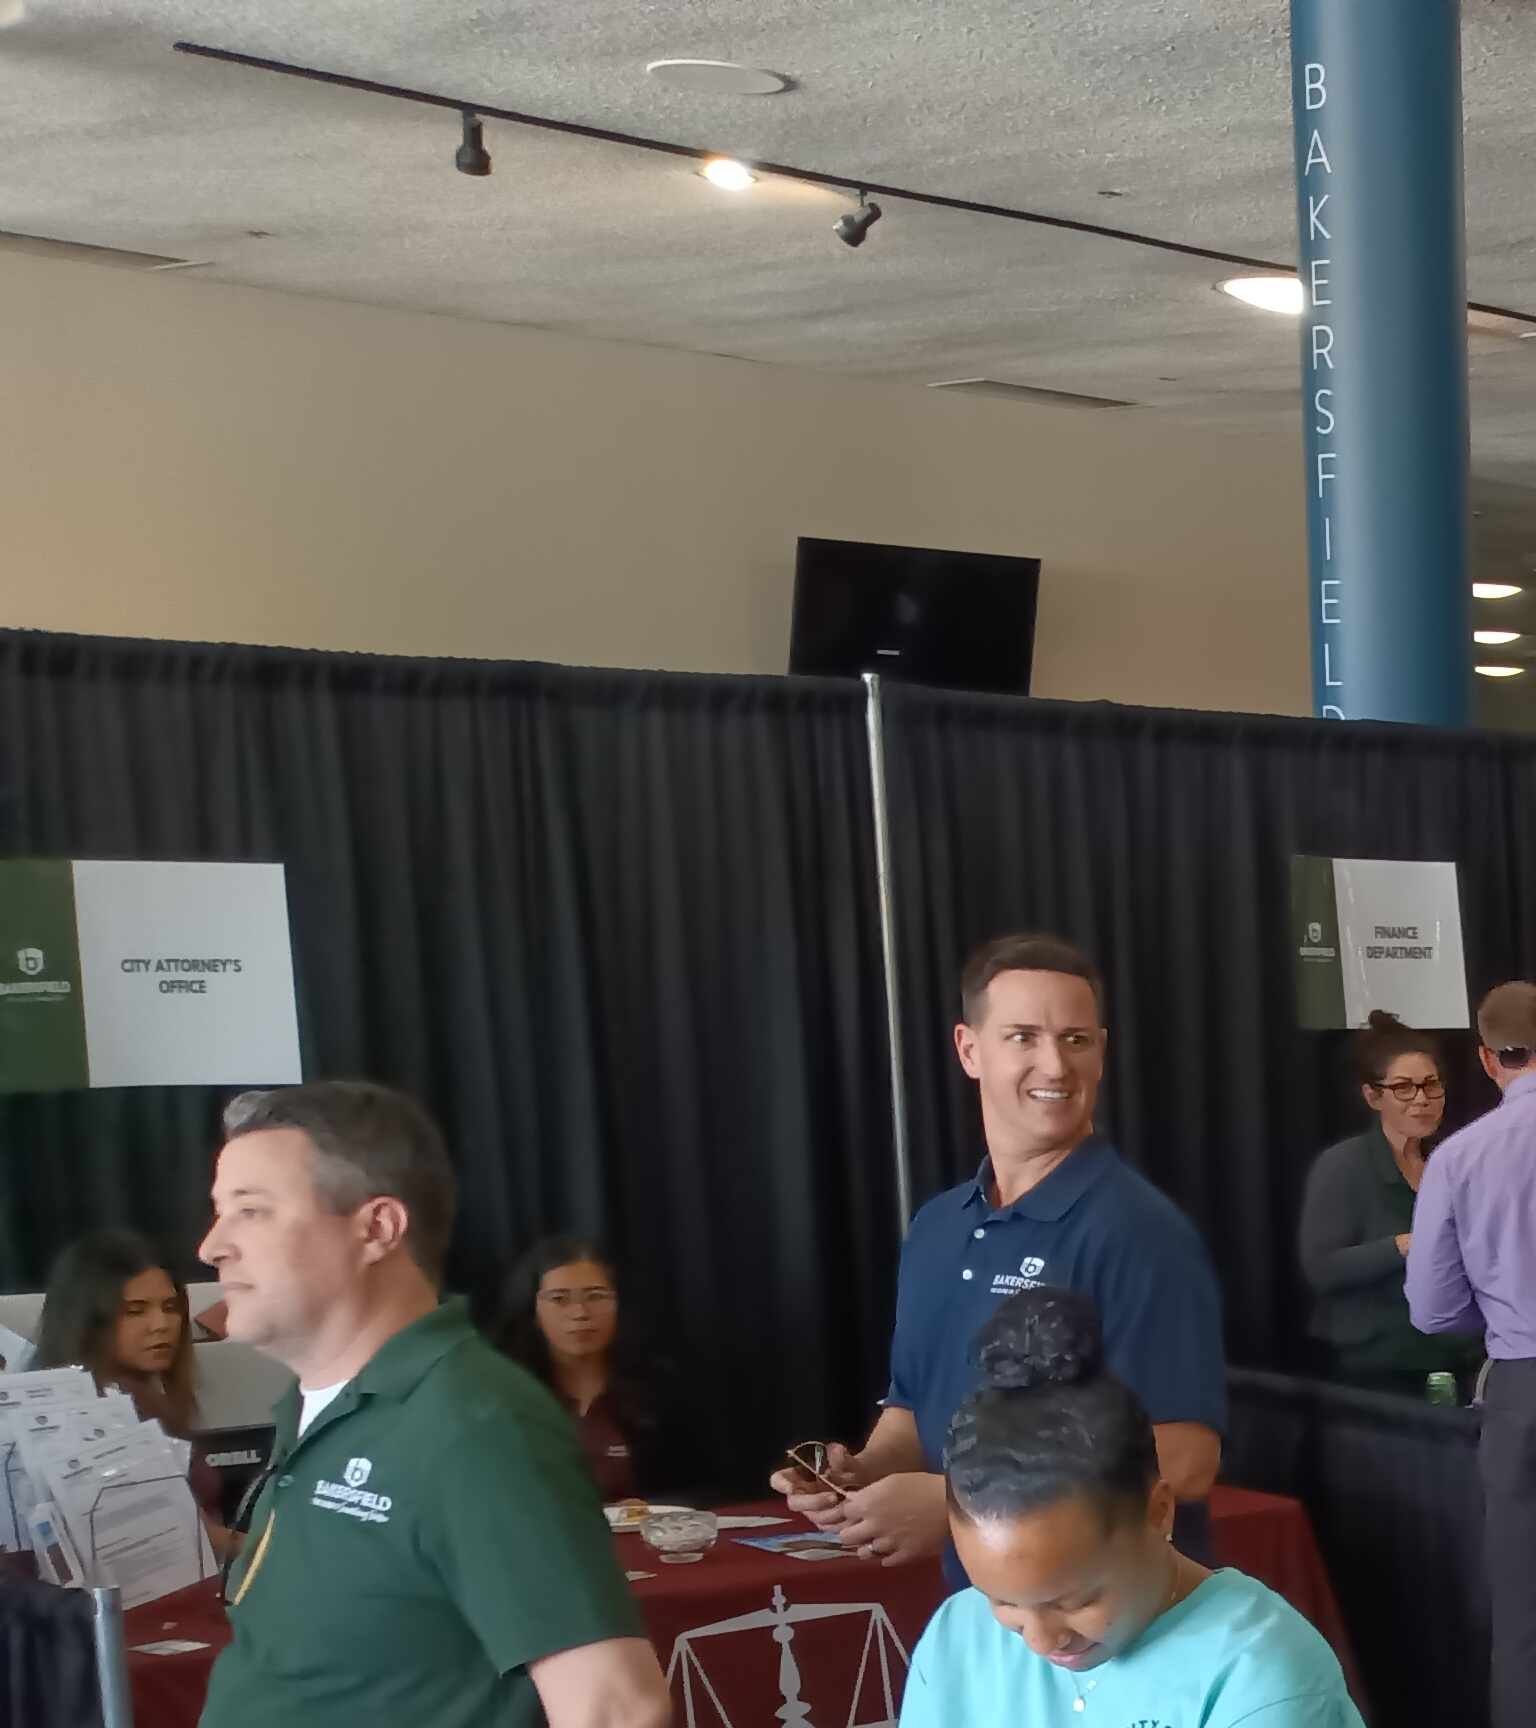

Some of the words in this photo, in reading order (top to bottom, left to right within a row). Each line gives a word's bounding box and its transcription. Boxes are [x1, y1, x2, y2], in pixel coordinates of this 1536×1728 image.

[1374, 925, 1419, 940] FINANCE
[1366, 946, 1434, 960] DEPARTMENT
[120, 958, 151, 974] CITY
[153, 958, 242, 974] ATTORNEY'S
[158, 979, 208, 995] OFFICE
